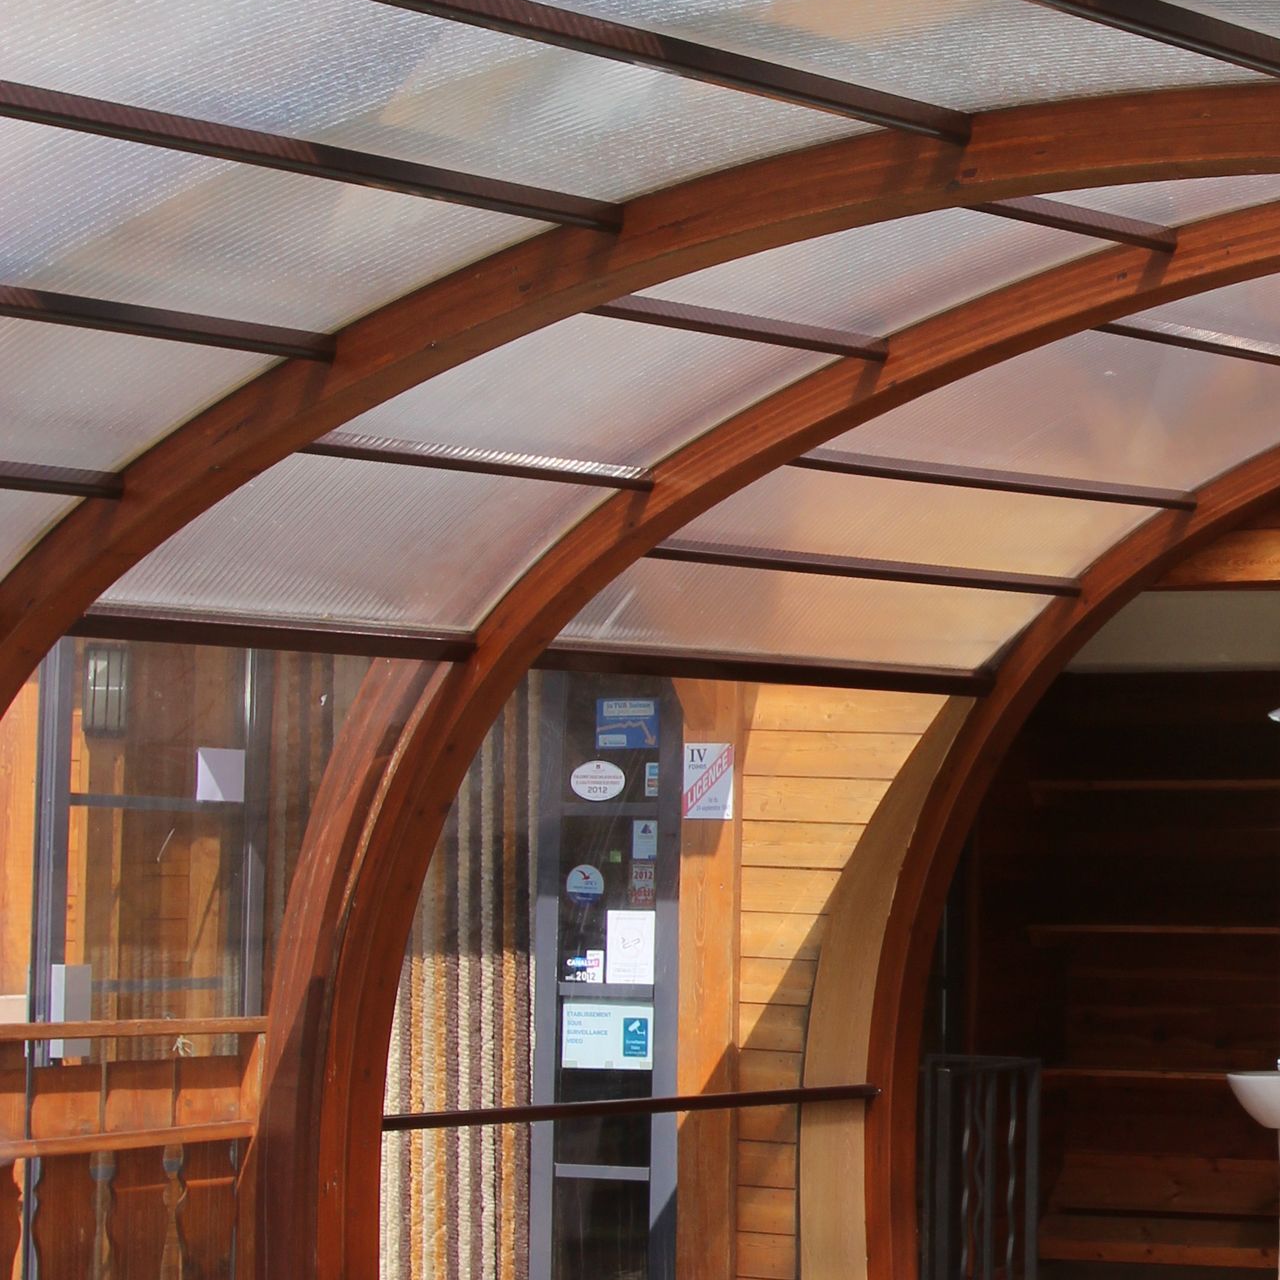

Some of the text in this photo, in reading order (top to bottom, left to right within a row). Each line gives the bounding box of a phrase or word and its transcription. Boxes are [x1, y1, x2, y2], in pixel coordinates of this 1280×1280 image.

[689, 748, 707, 762] IV
[688, 751, 728, 807] LICENCE
[587, 785, 608, 794] 2012
[634, 871, 653, 880] 2012
[576, 972, 596, 981] 2012
